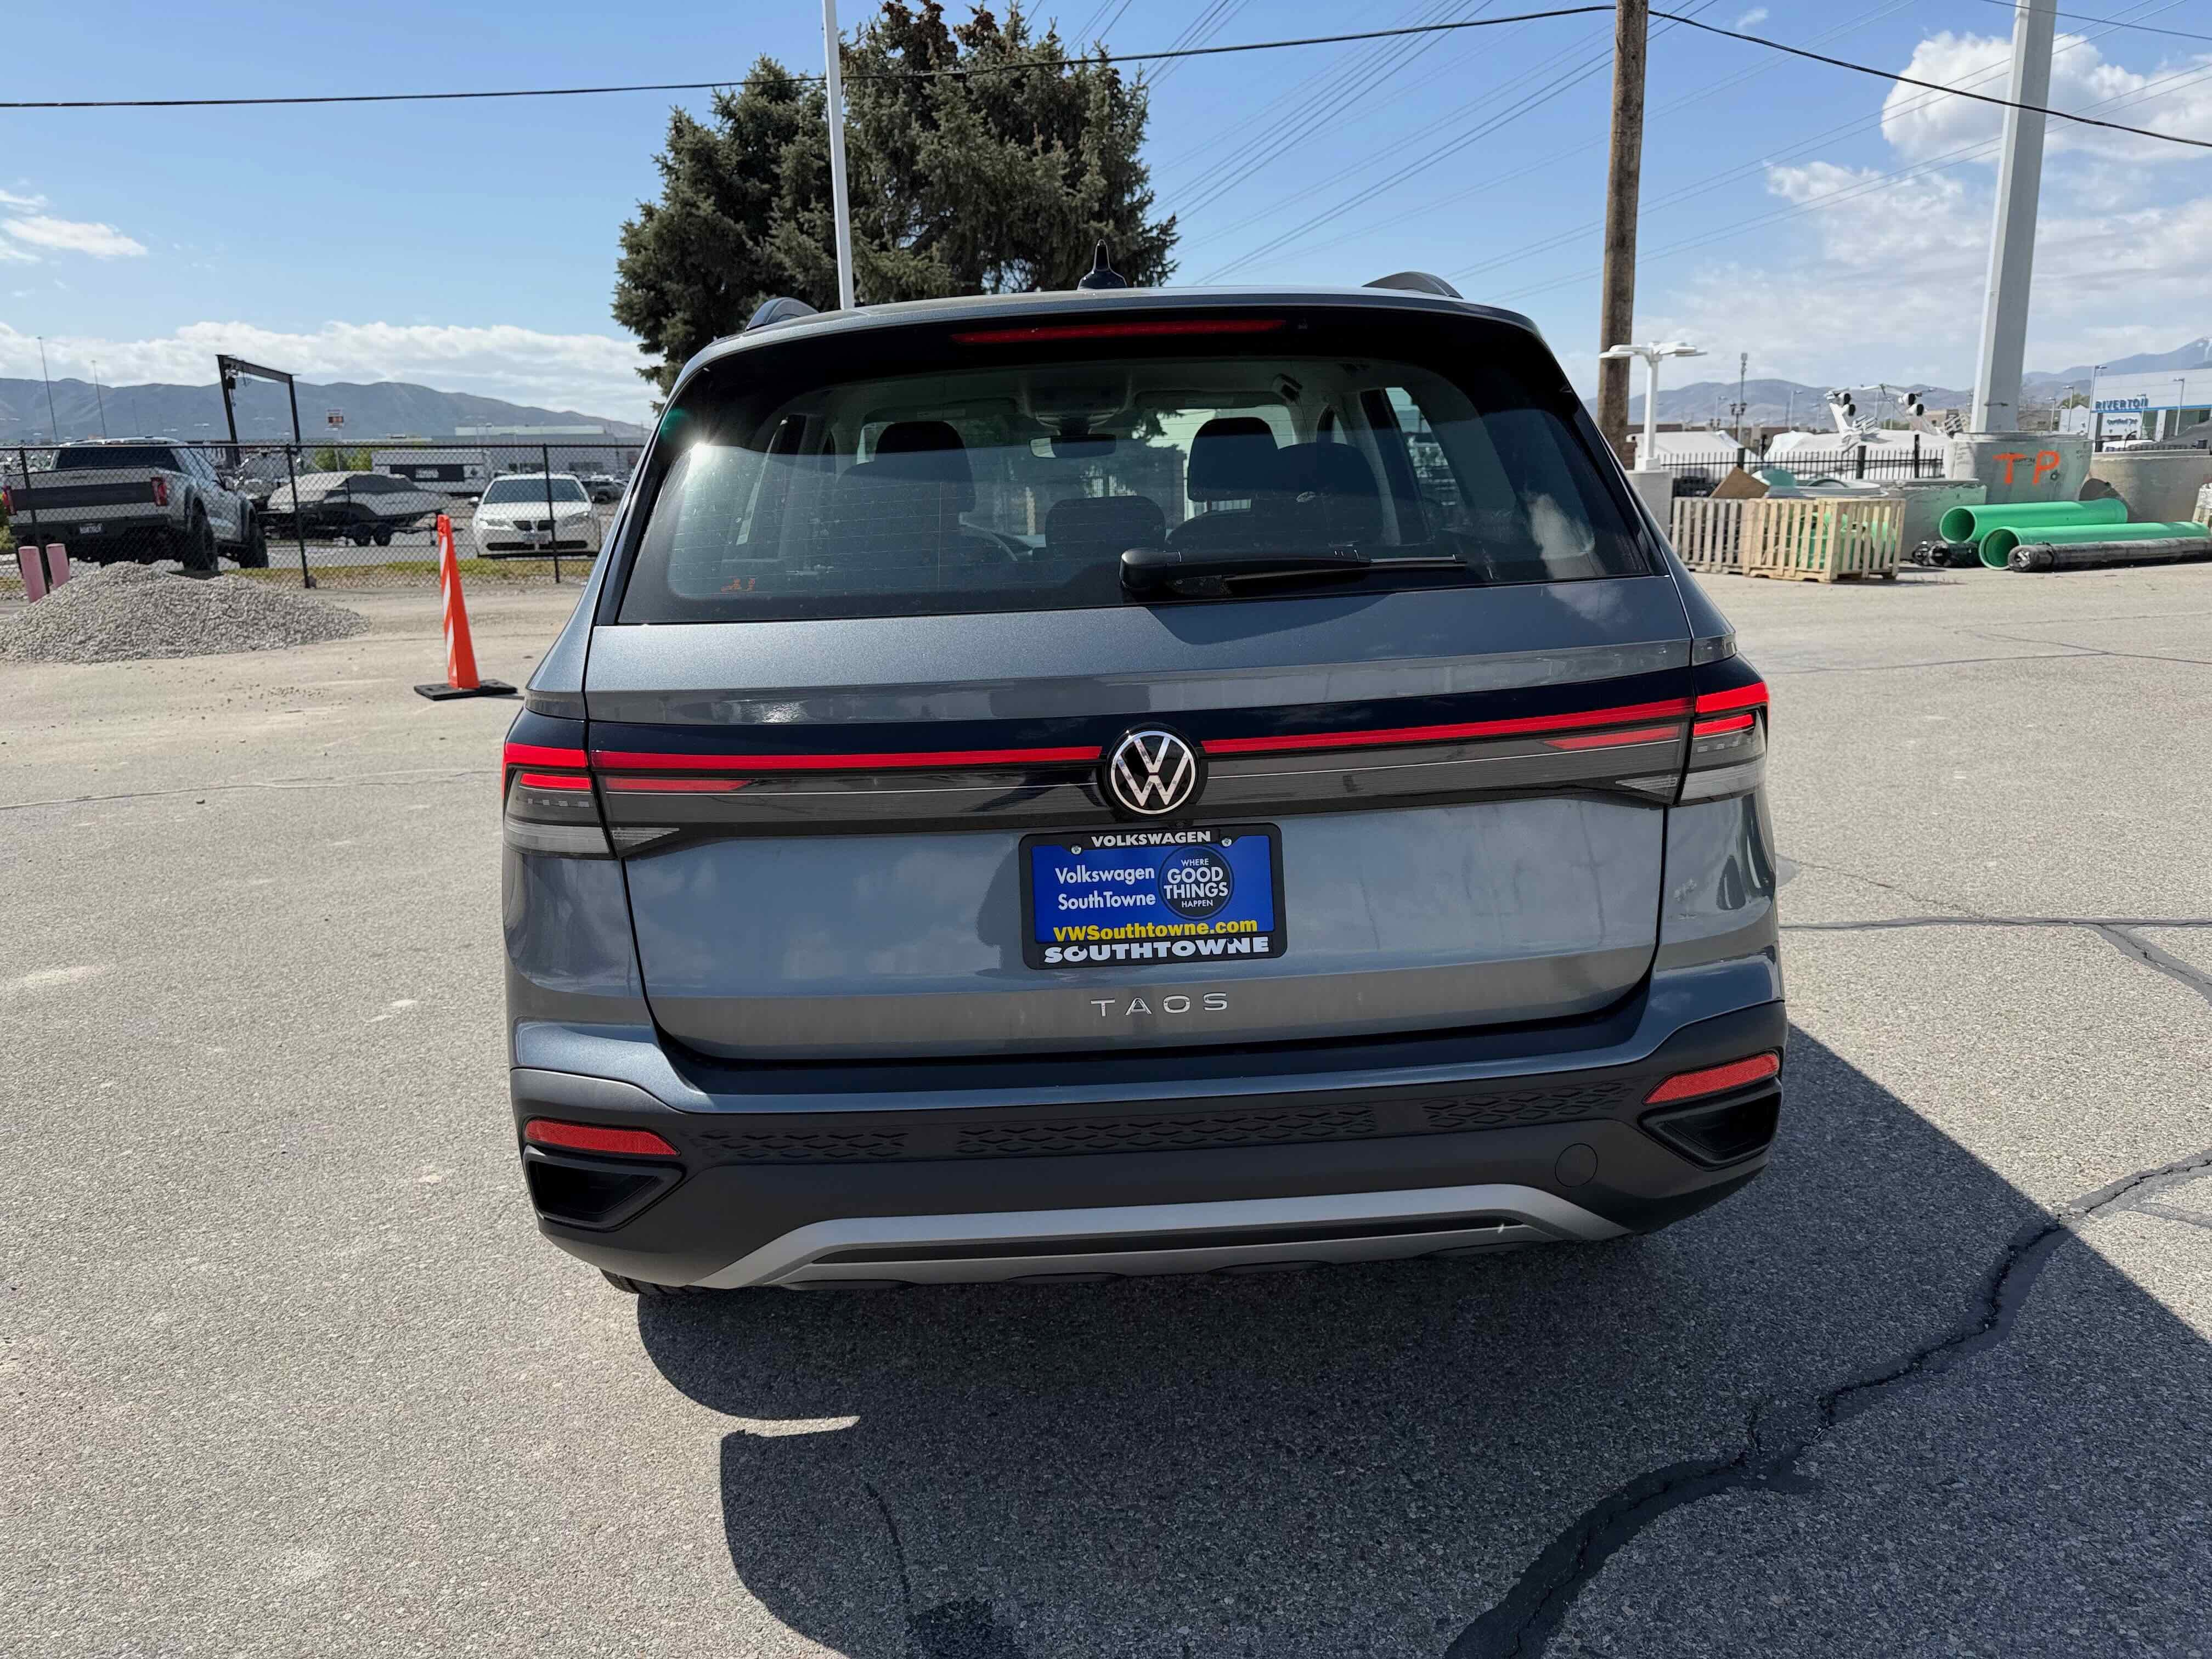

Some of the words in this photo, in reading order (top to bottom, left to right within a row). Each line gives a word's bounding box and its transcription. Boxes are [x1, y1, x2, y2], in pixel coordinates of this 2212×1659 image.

[2095, 398, 2148, 409] RIVERTON
[1114, 734, 1192, 809] VW
[1091, 831, 1211, 848] VOLKSWAGEN
[1181, 858, 1209, 866] WHERE
[1054, 866, 1155, 885] Volkswagen
[1167, 867, 1223, 883] GOOD
[1163, 882, 1228, 900] THINGS
[1057, 891, 1156, 910] SouthTowne
[1181, 899, 1214, 908] HAPPEN
[1053, 919, 1257, 942] VWSouthtowne.com
[1044, 936, 1269, 964] SOUTHTOWNE
[1090, 992, 1228, 1017] TAOS
